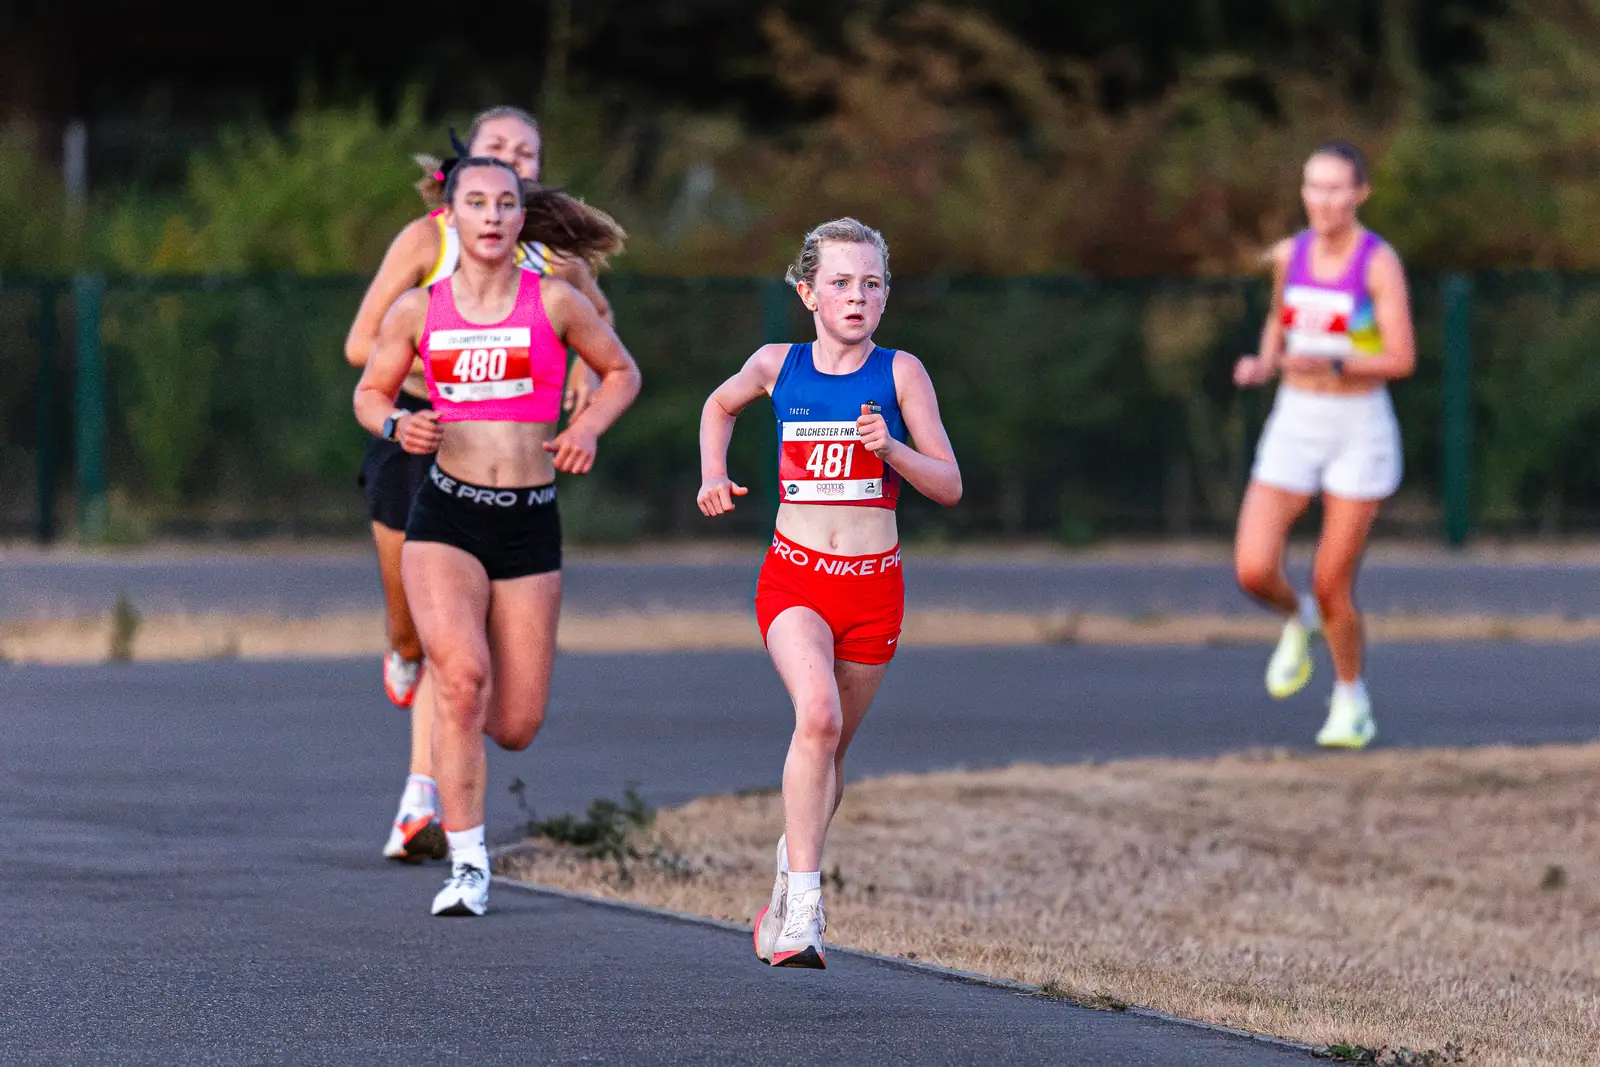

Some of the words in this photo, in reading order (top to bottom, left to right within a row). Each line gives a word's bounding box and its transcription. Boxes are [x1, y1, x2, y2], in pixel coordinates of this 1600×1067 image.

[452, 347, 508, 383] 480
[789, 407, 810, 416] TACTIC
[795, 427, 839, 437] COLCHESTER
[840, 427, 854, 437] FNR
[806, 443, 855, 478] 481
[456, 484, 518, 507] PRO
[814, 557, 878, 577] NIKE
